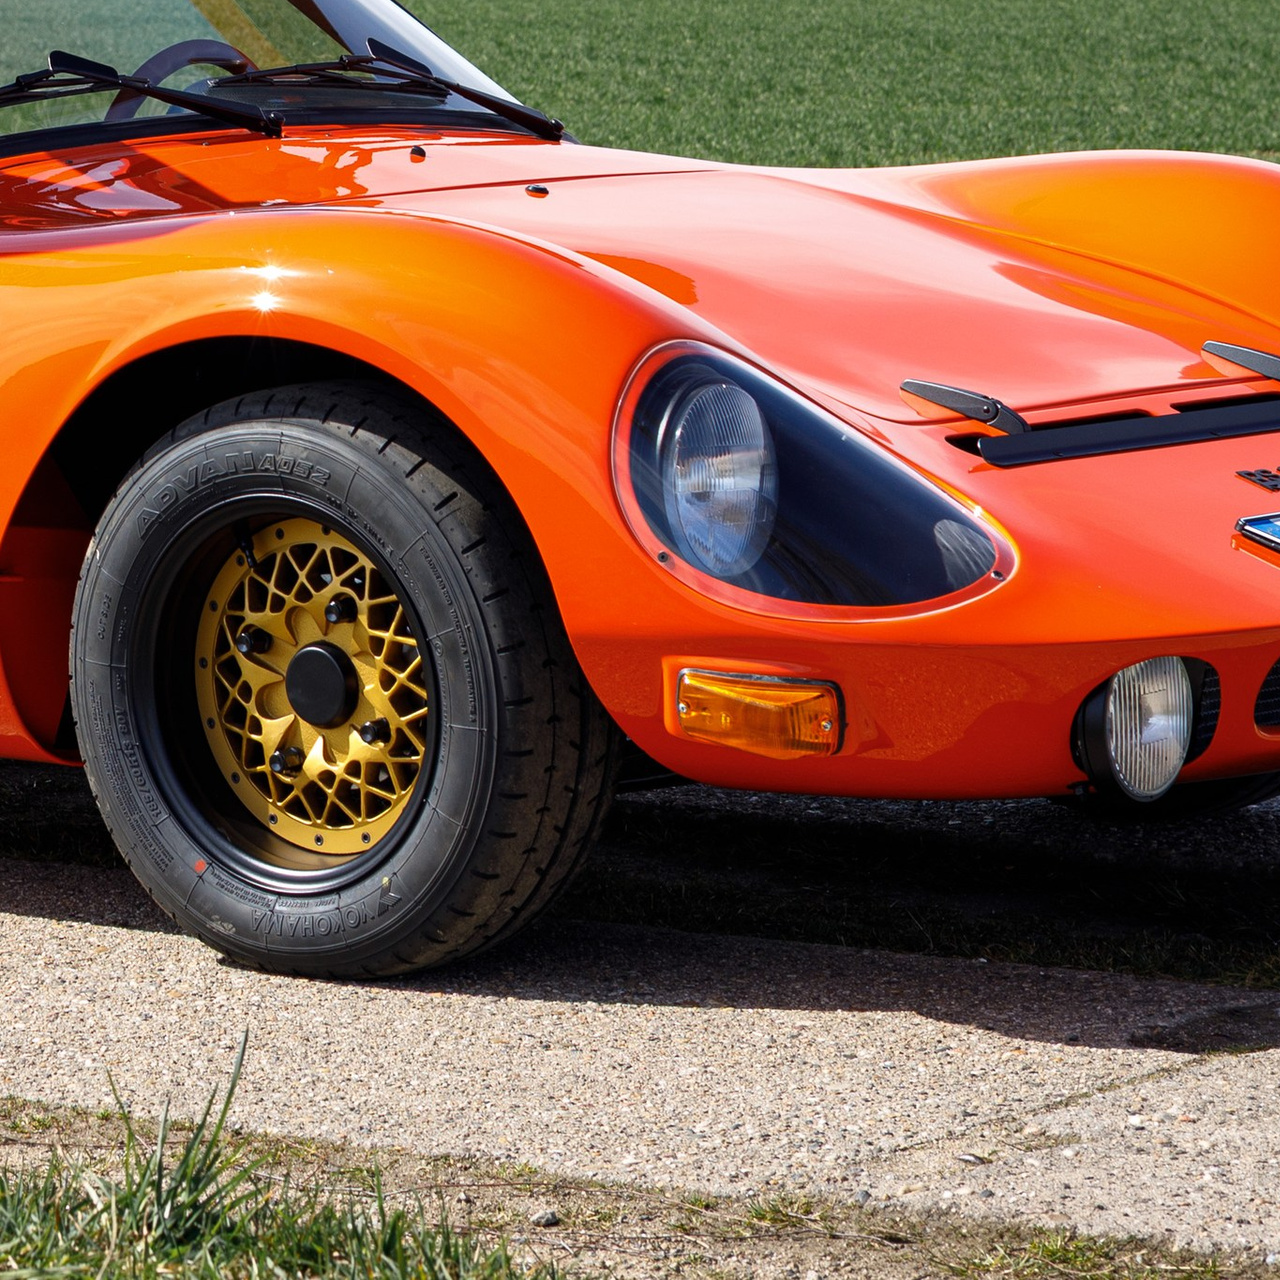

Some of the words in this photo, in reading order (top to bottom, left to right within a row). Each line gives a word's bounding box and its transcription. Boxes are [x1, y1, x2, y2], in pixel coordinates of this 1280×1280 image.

[136, 450, 255, 538] ADVAN
[257, 453, 331, 486] A052
[251, 903, 376, 939] YOKOHAMA
